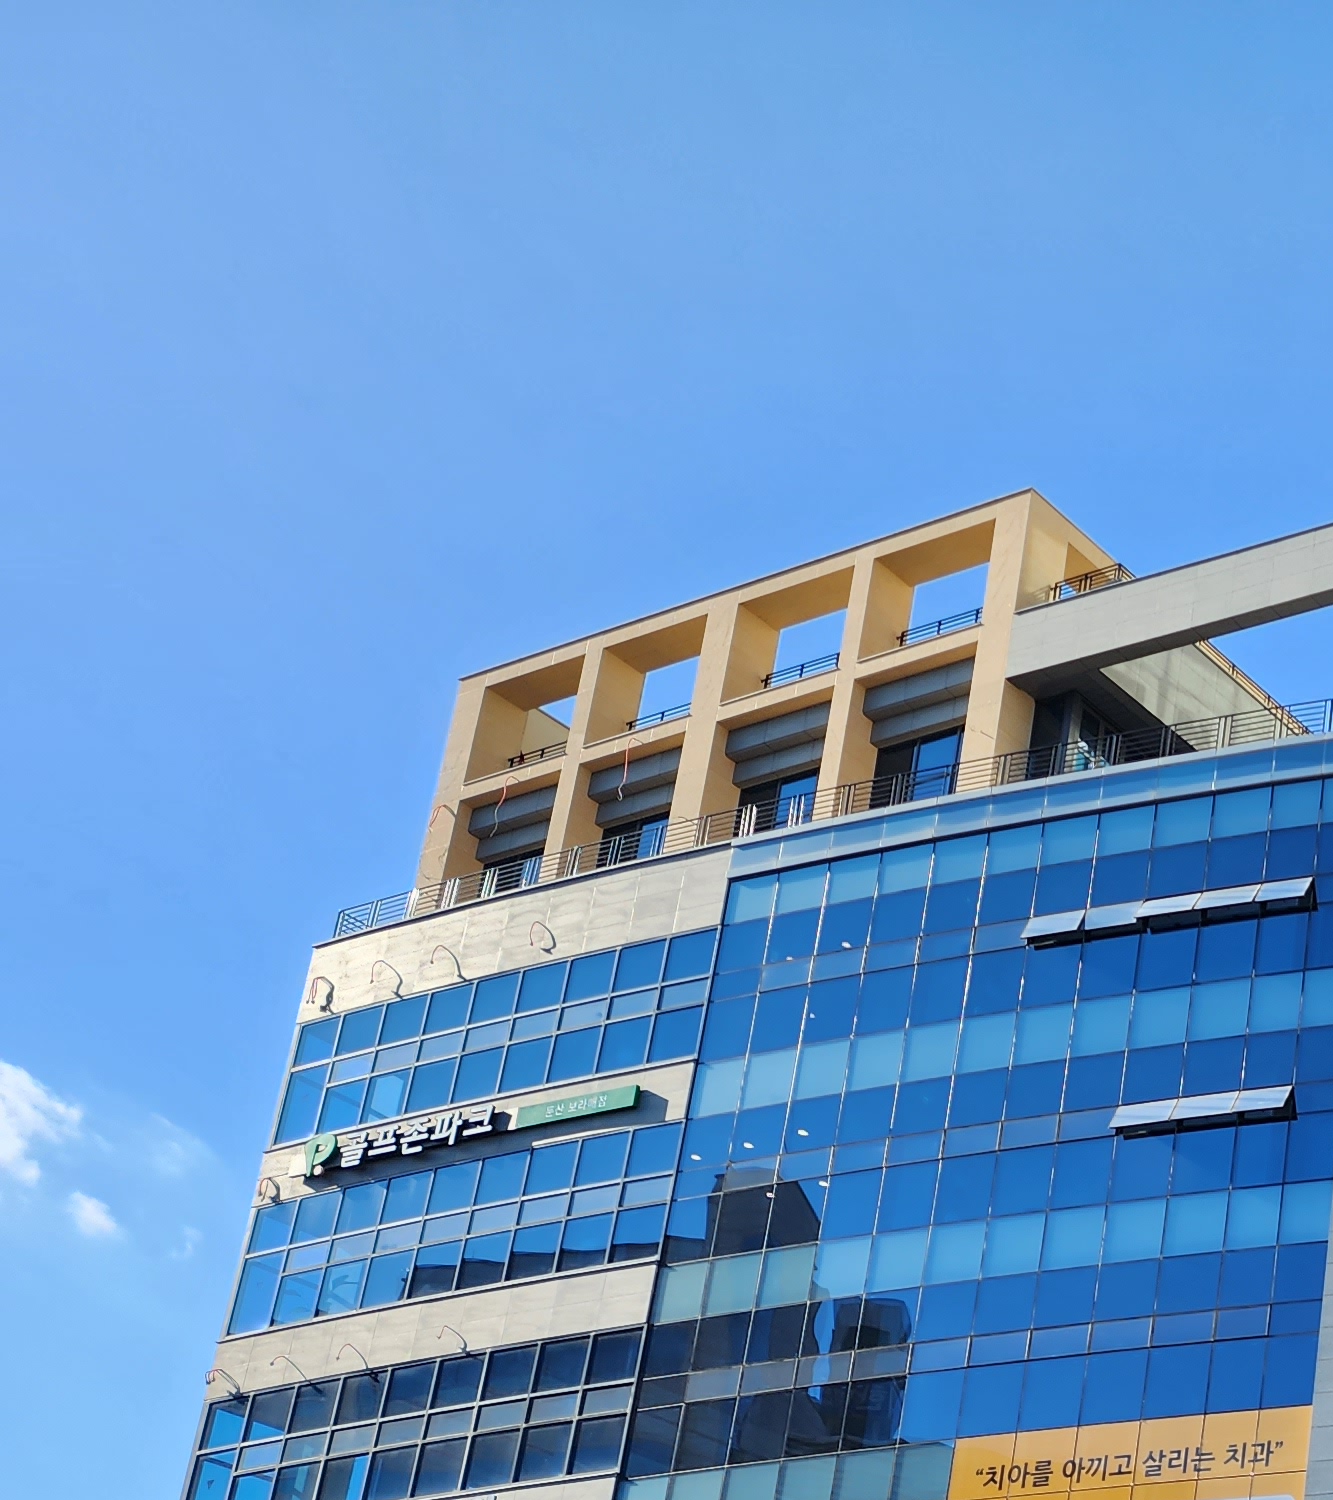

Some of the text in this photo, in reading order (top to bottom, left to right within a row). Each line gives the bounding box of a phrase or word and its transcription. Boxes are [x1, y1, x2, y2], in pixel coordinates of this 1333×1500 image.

[545, 1095, 608, 1118] 둔산 보라매점
[339, 1104, 496, 1168] 골프존파크
[1062, 1454, 1133, 1483] 아끼고
[1142, 1445, 1215, 1477] 살리는
